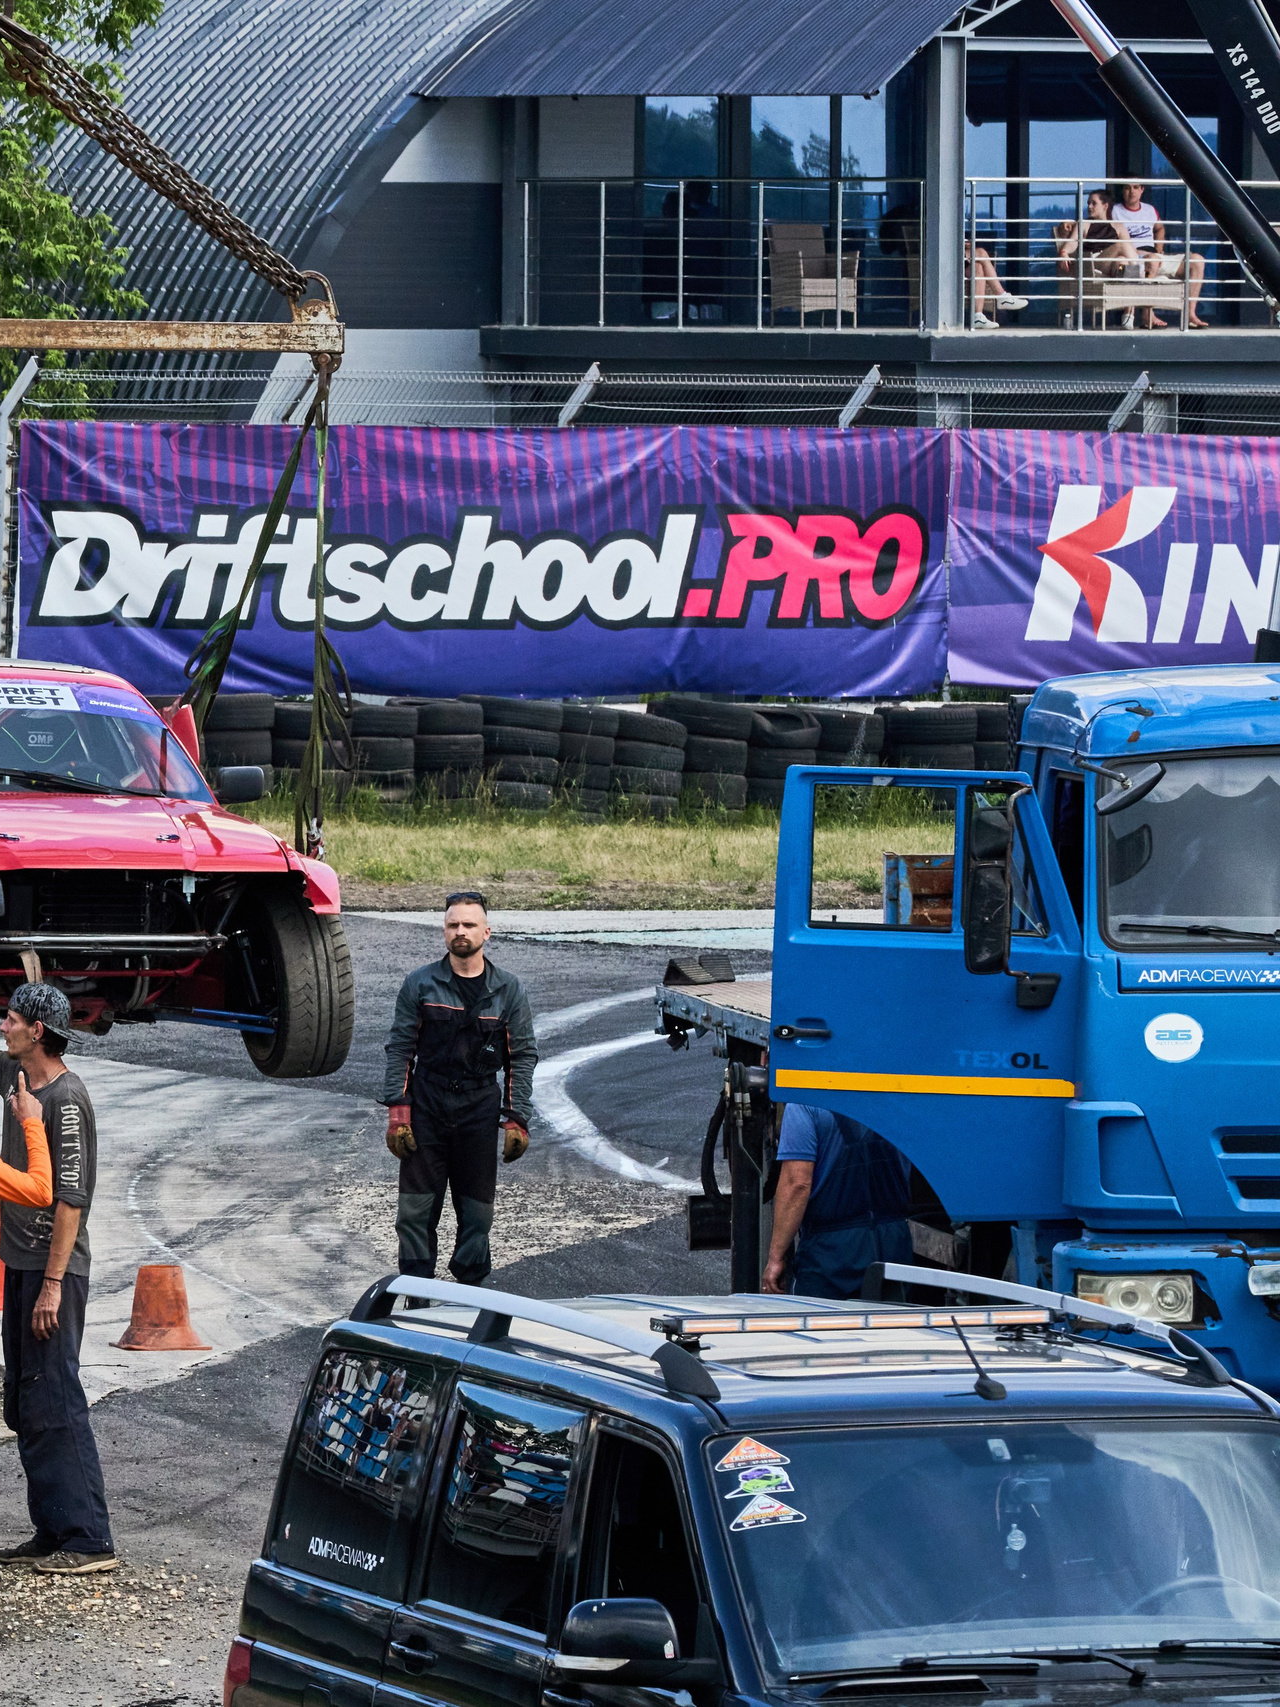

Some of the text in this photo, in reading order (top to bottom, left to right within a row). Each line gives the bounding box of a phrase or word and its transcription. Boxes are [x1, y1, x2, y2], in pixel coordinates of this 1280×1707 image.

[1226, 42, 1280, 134] XS 144 DUO
[39, 510, 924, 623] Driftschool.PRO
[28, 734, 54, 744] OMP
[1138, 969, 1263, 983] ADMRACEWAY
[952, 1050, 1049, 1070] TEXOL
[60, 1104, 80, 1151] DON'T
[307, 1536, 368, 1568] ADMRACEWAY
